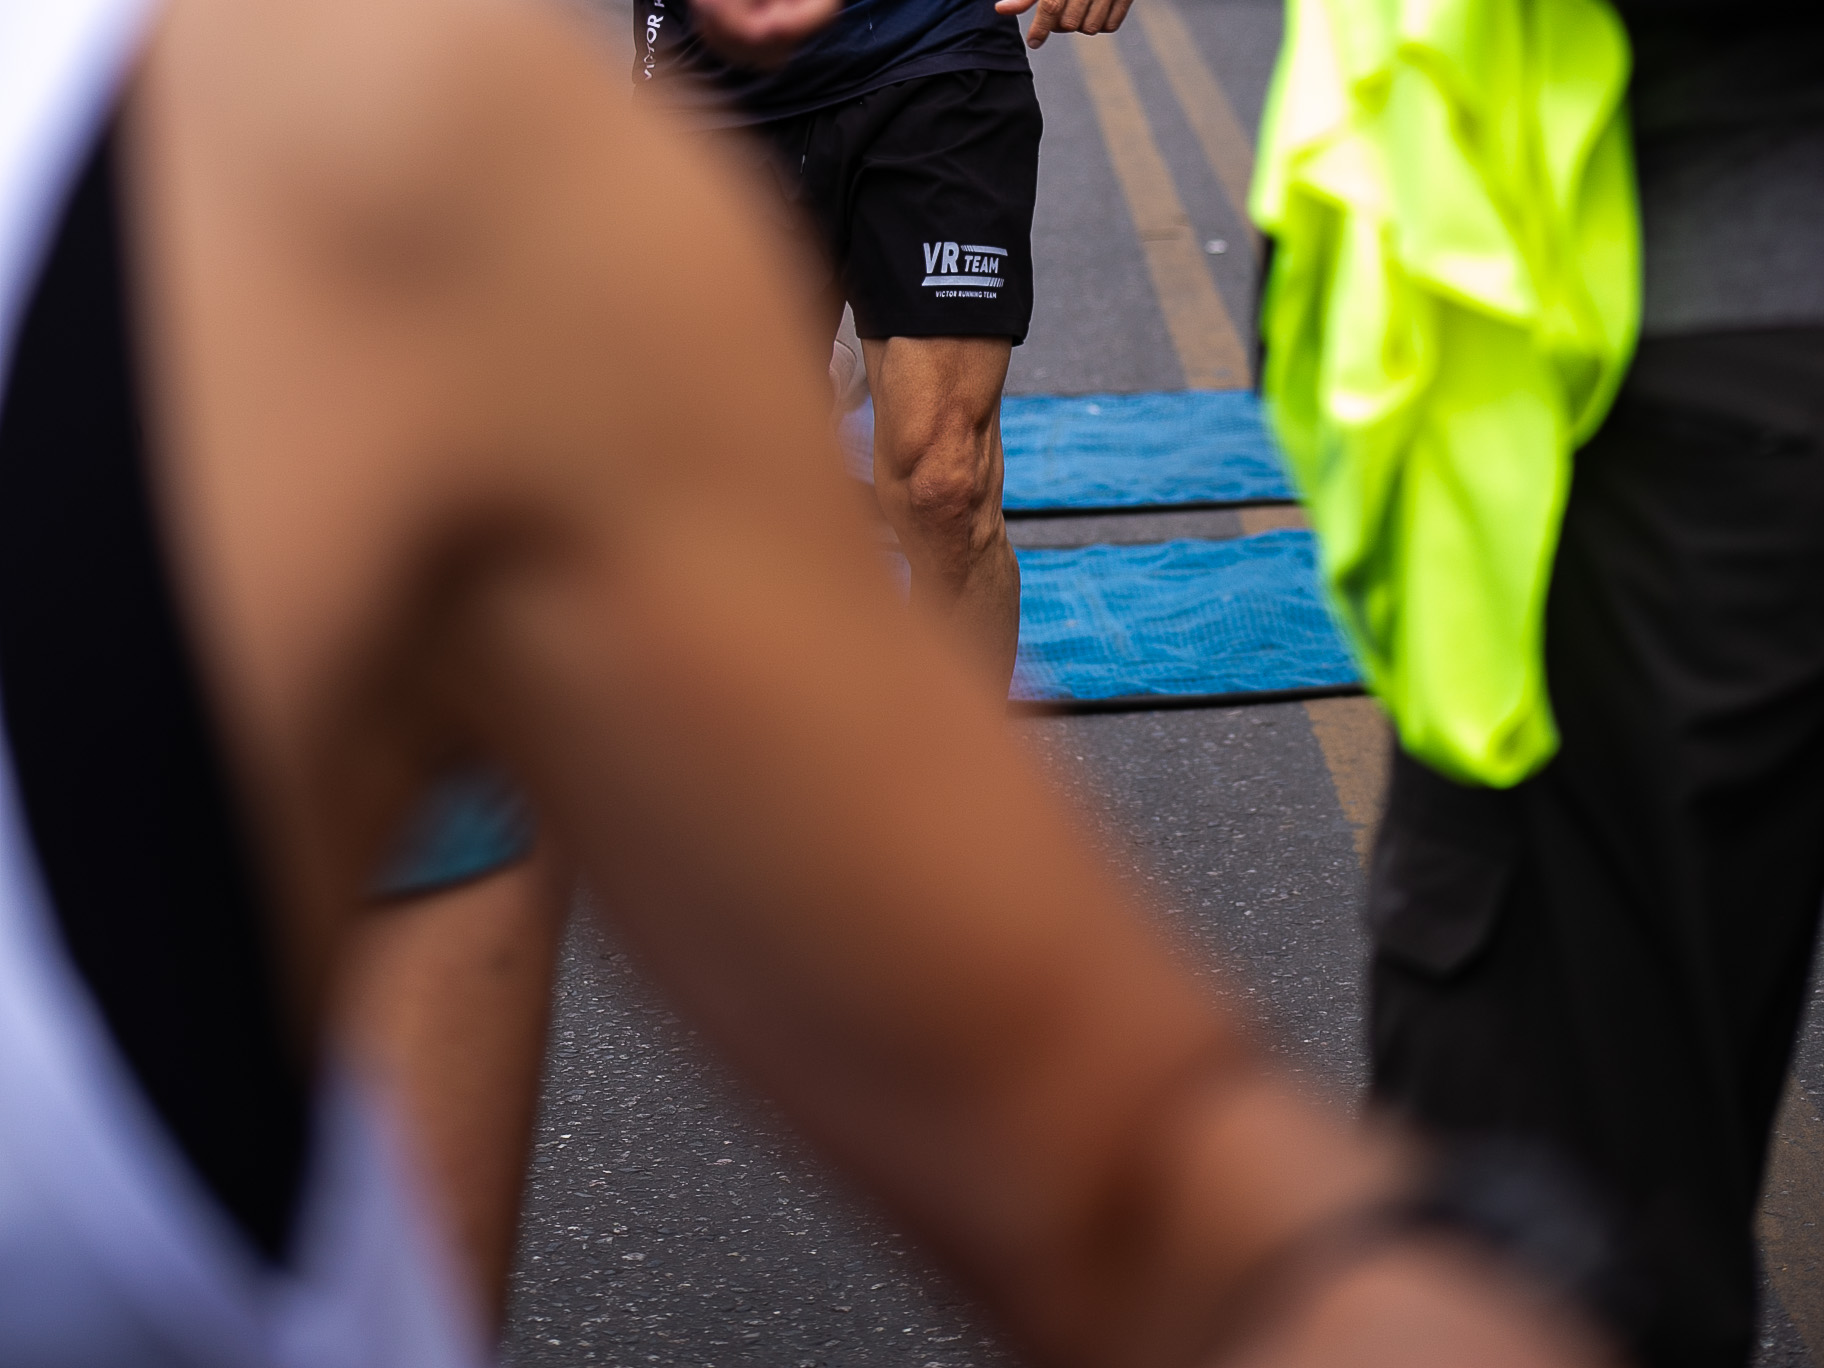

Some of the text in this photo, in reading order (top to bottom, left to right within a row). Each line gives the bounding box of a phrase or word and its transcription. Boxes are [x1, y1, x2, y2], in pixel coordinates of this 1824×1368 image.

[923, 241, 999, 274] VR TEAM
[935, 290, 957, 298] VICTOR
[984, 291, 997, 299] TEAM
